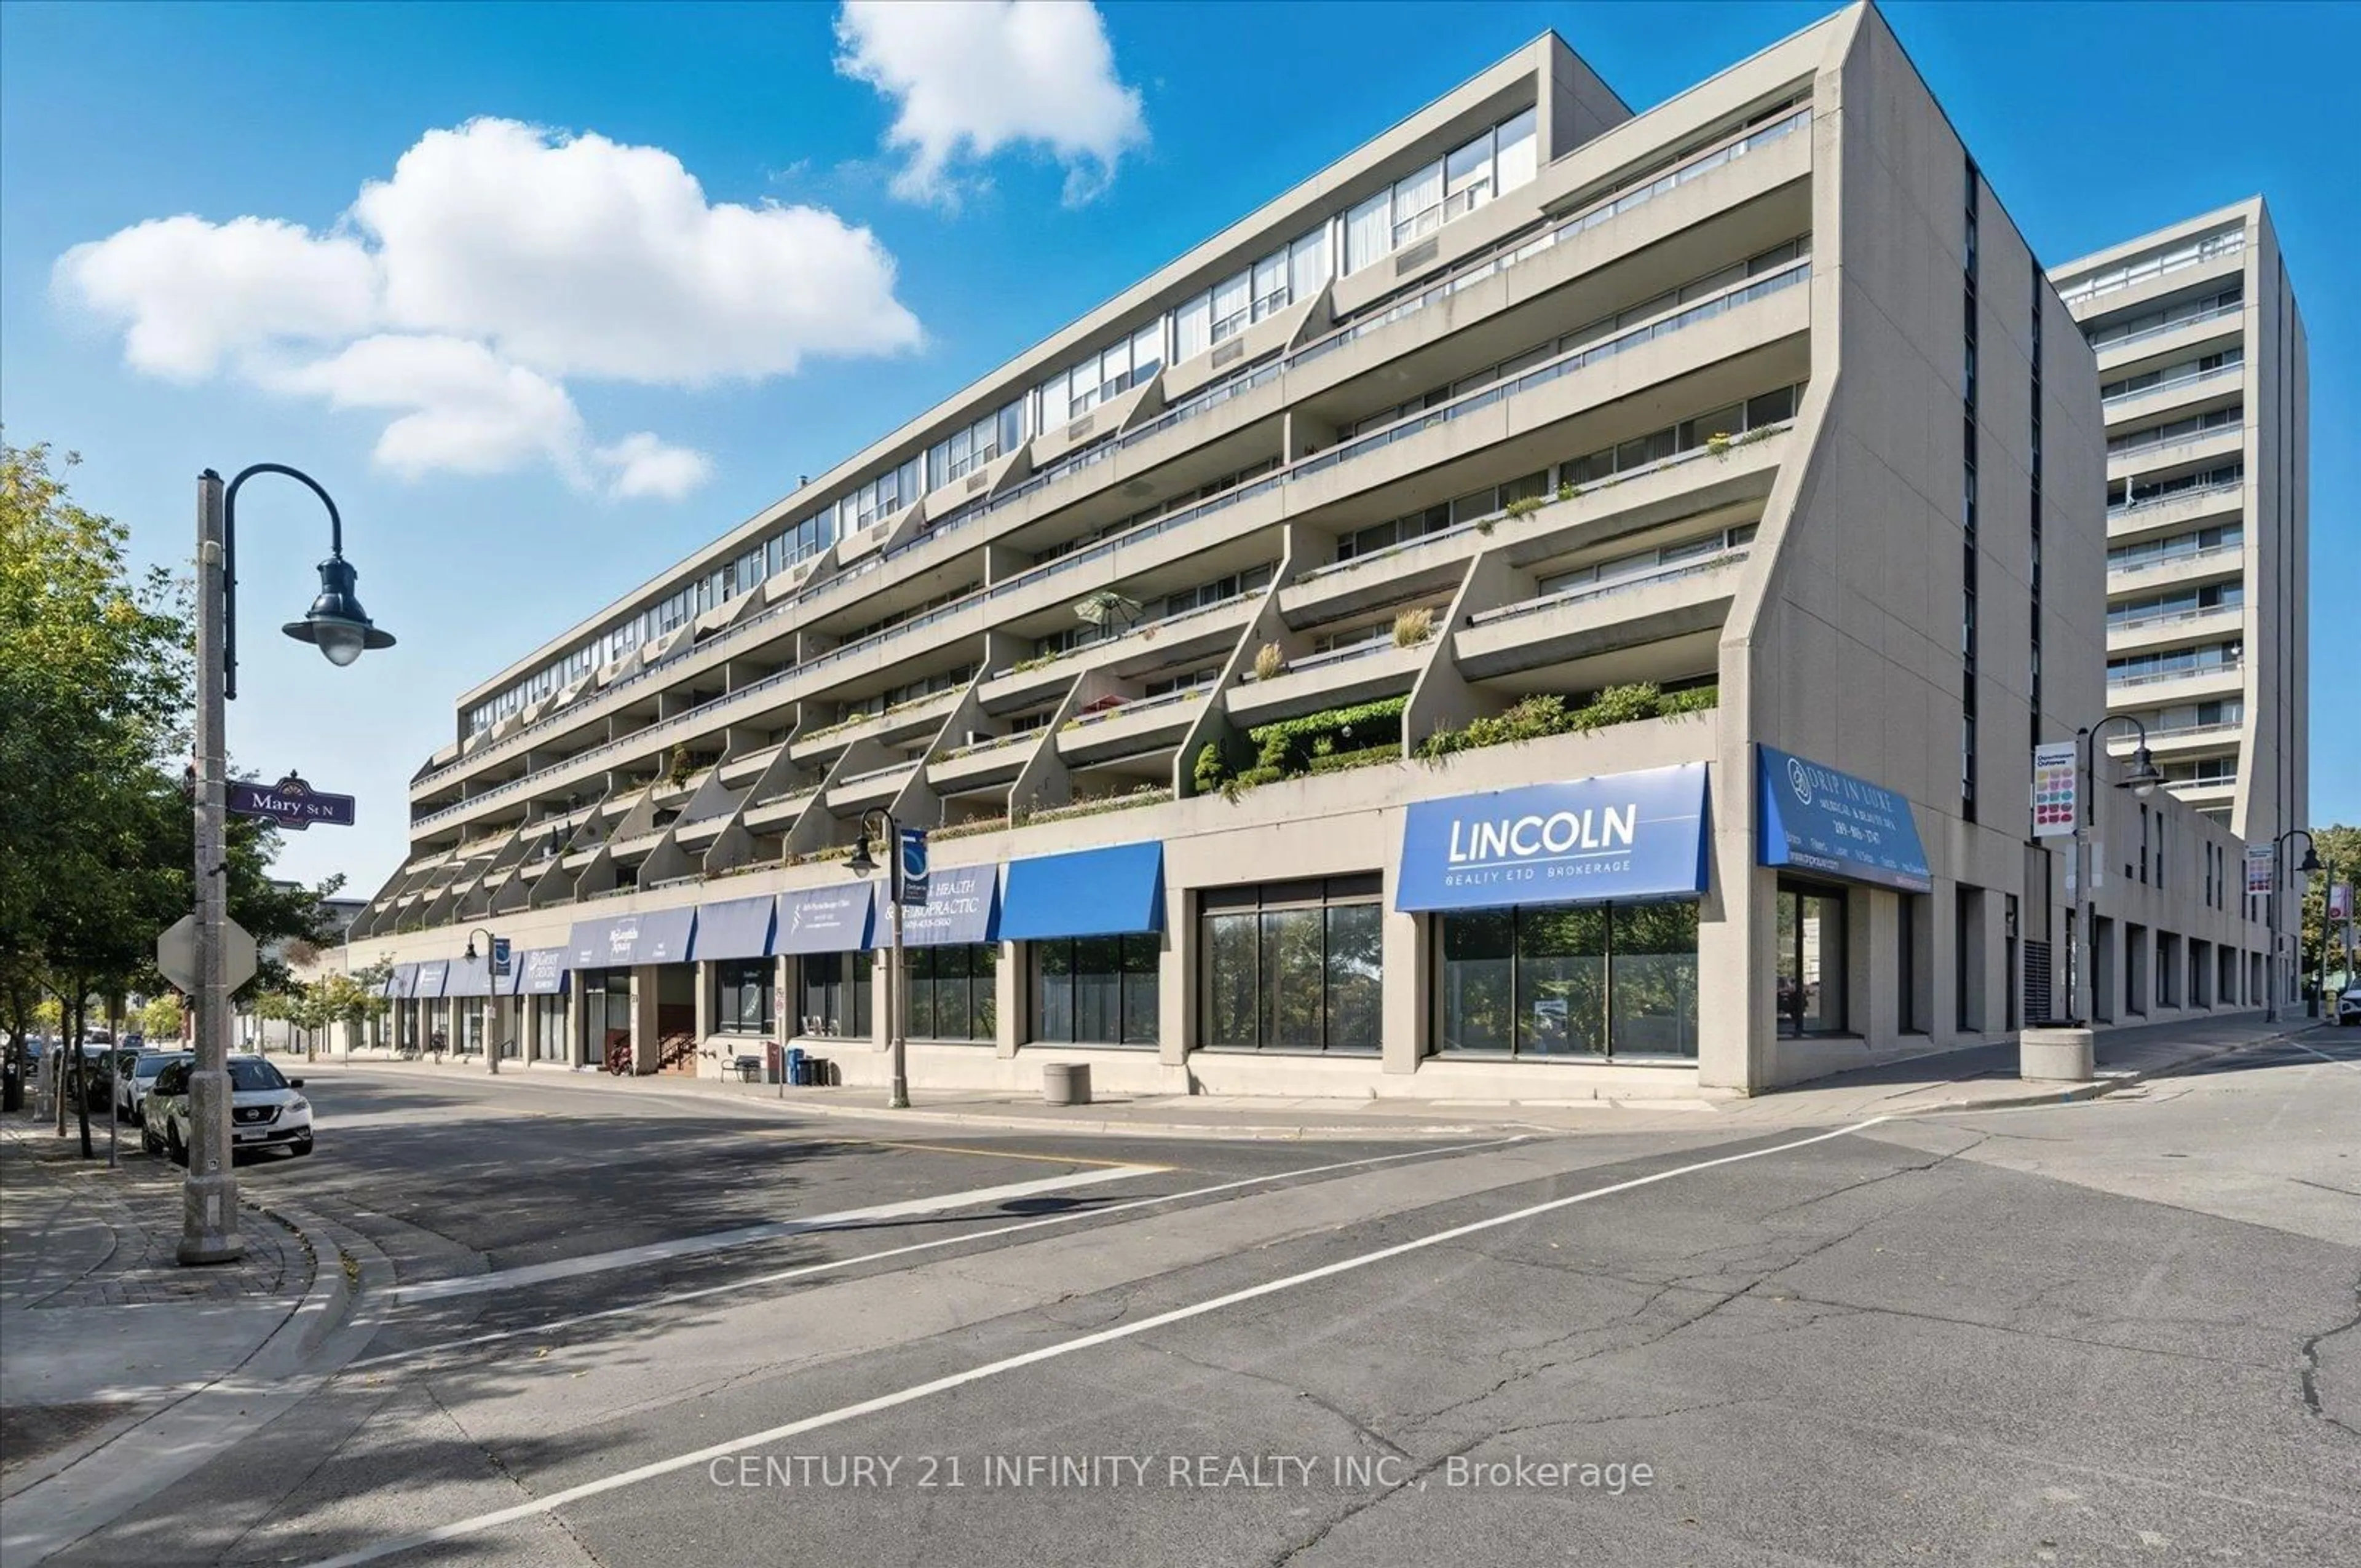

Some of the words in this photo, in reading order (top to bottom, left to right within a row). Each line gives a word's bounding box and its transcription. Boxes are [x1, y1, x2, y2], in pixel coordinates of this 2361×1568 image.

[252, 792, 301, 816] Mary
[307, 803, 319, 816] St
[323, 806, 333, 816] N
[1449, 803, 1636, 862] LINCOLN
[1547, 860, 1631, 878] BROKERAGE
[935, 880, 976, 896] HEALTH
[901, 897, 979, 918] HIROPRACTIC
